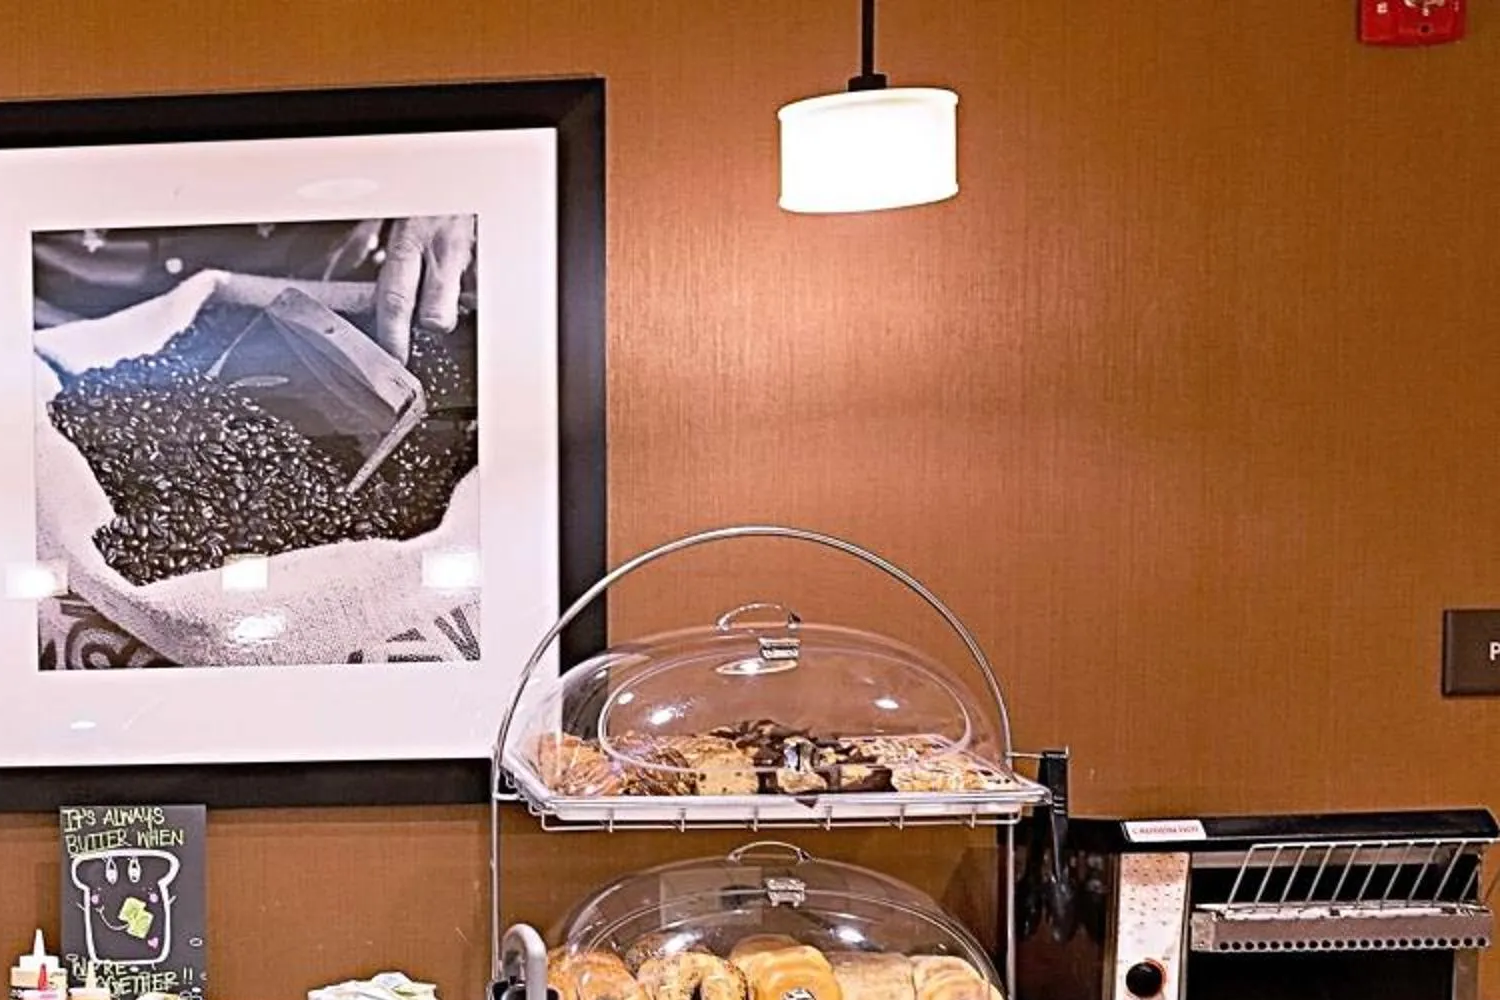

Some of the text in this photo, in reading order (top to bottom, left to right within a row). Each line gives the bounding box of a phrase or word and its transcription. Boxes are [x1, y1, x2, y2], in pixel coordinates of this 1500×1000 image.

[102, 806, 165, 831] ALWAYS
[65, 829, 184, 858] BUTTER WHEN
